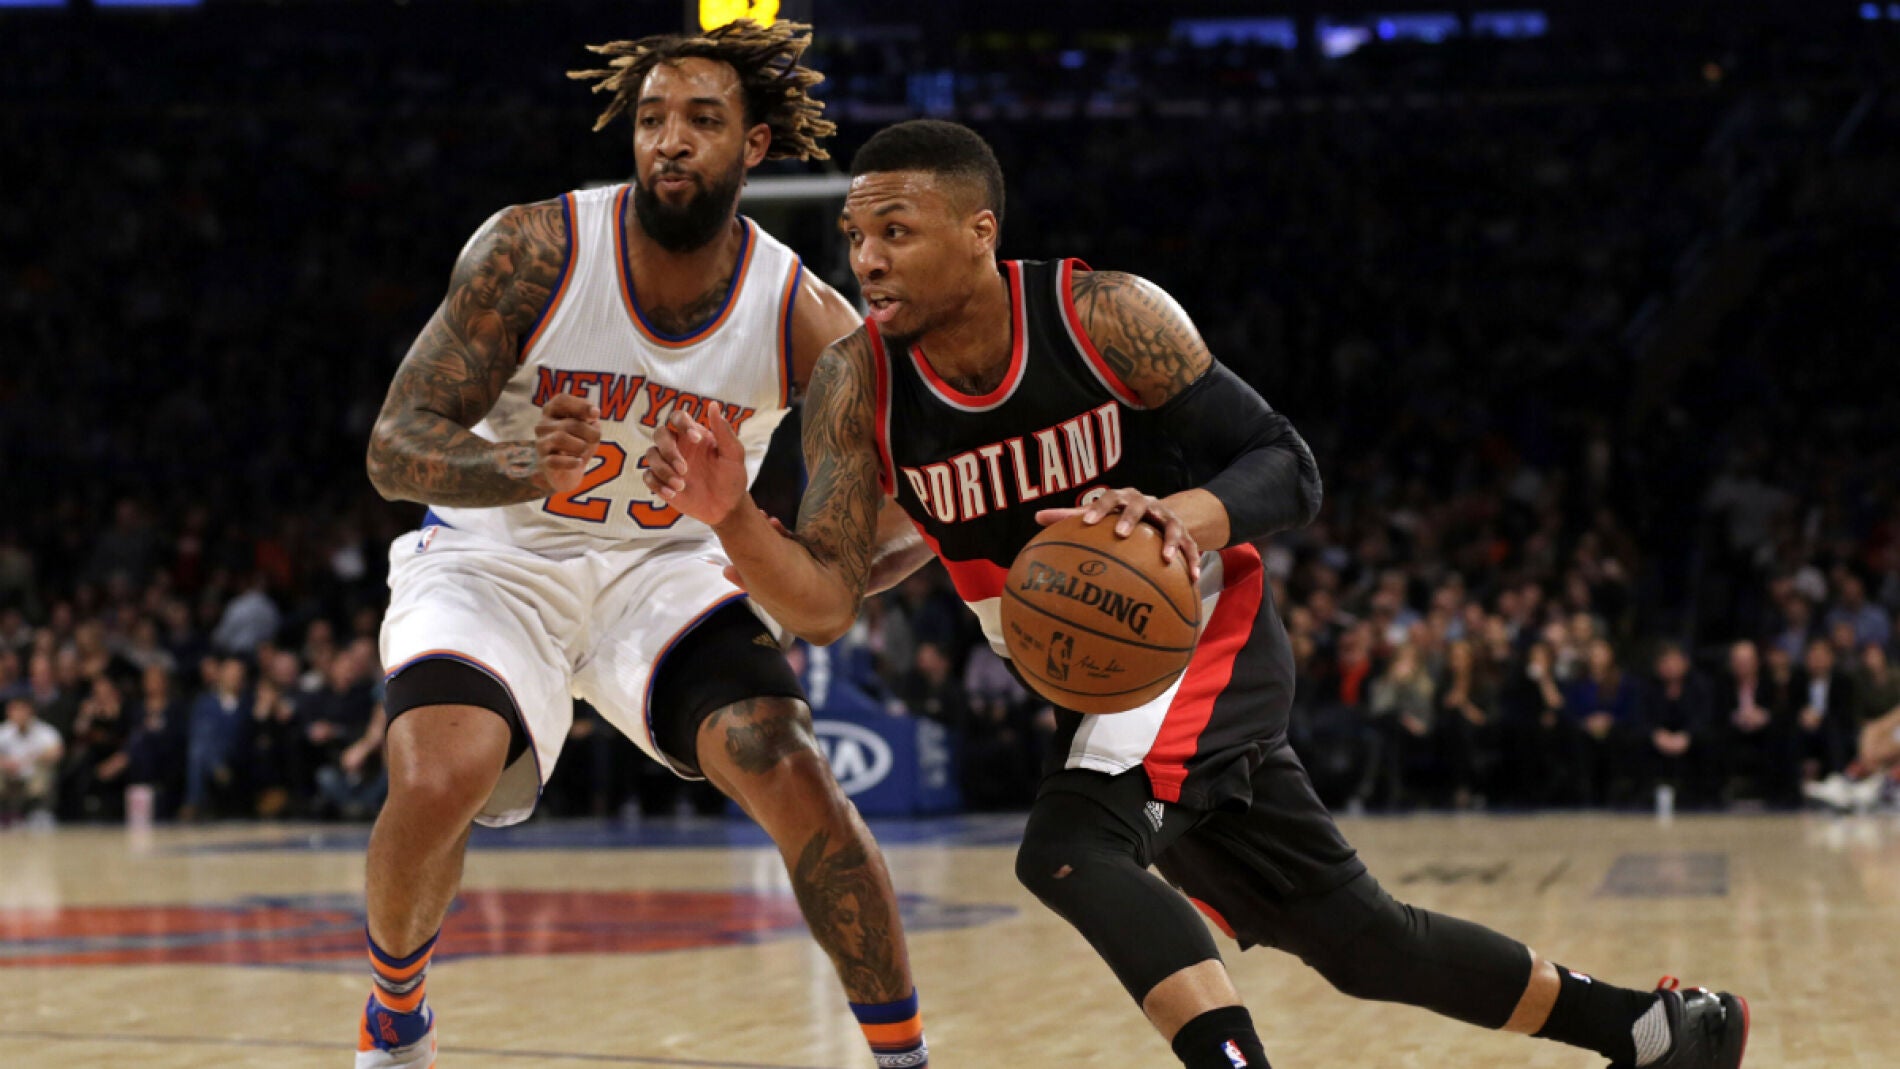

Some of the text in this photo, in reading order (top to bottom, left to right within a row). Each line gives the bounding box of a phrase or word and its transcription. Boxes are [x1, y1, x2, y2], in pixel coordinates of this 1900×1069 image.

[532, 366, 645, 422] NEW
[900, 400, 1122, 524] PORTLAND
[1020, 561, 1153, 636] SPALDING
